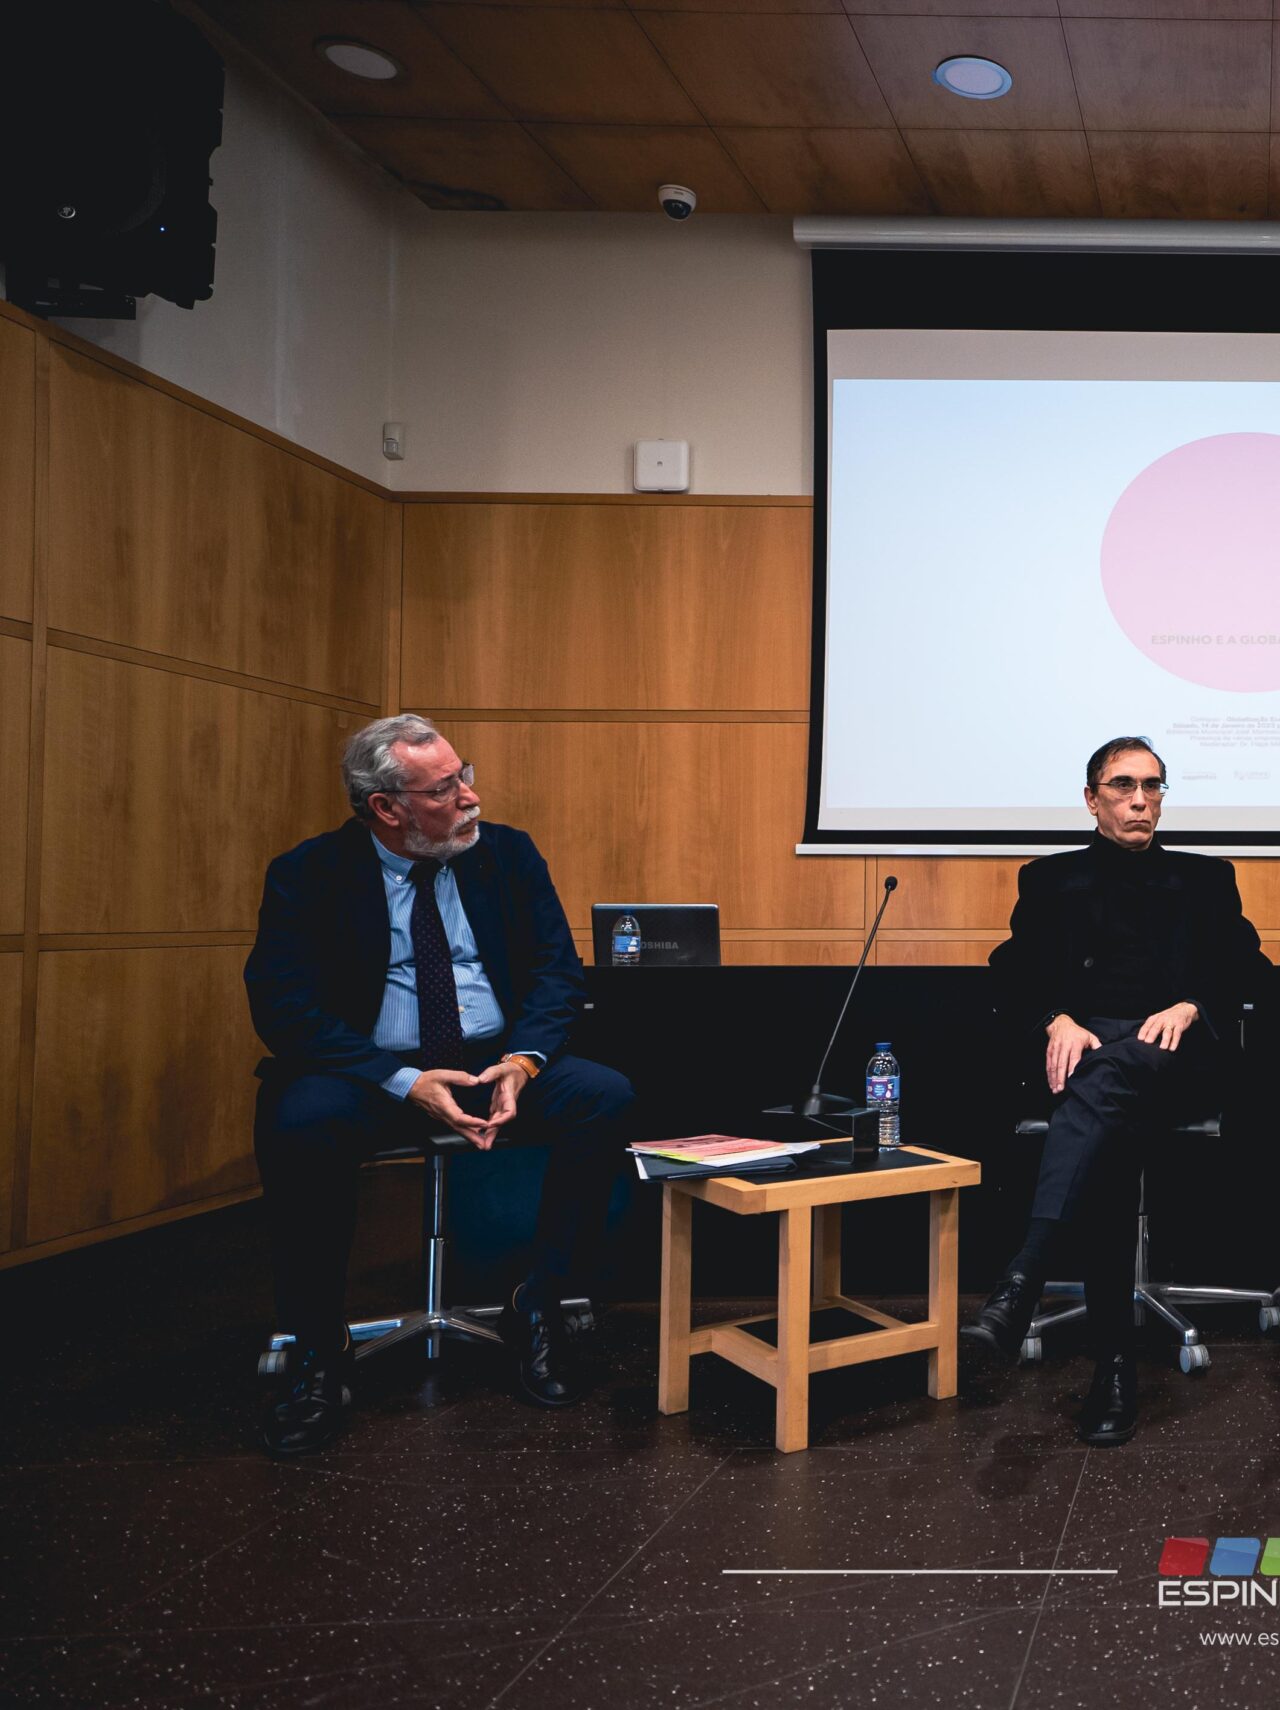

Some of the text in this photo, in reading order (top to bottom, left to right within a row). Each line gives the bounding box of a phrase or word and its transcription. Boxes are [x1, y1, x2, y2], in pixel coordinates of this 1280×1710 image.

[1151, 635, 1212, 645] ESPINHO
[1216, 635, 1224, 645] E
[1226, 635, 1237, 645] A
[639, 941, 679, 949] OSHIBA
